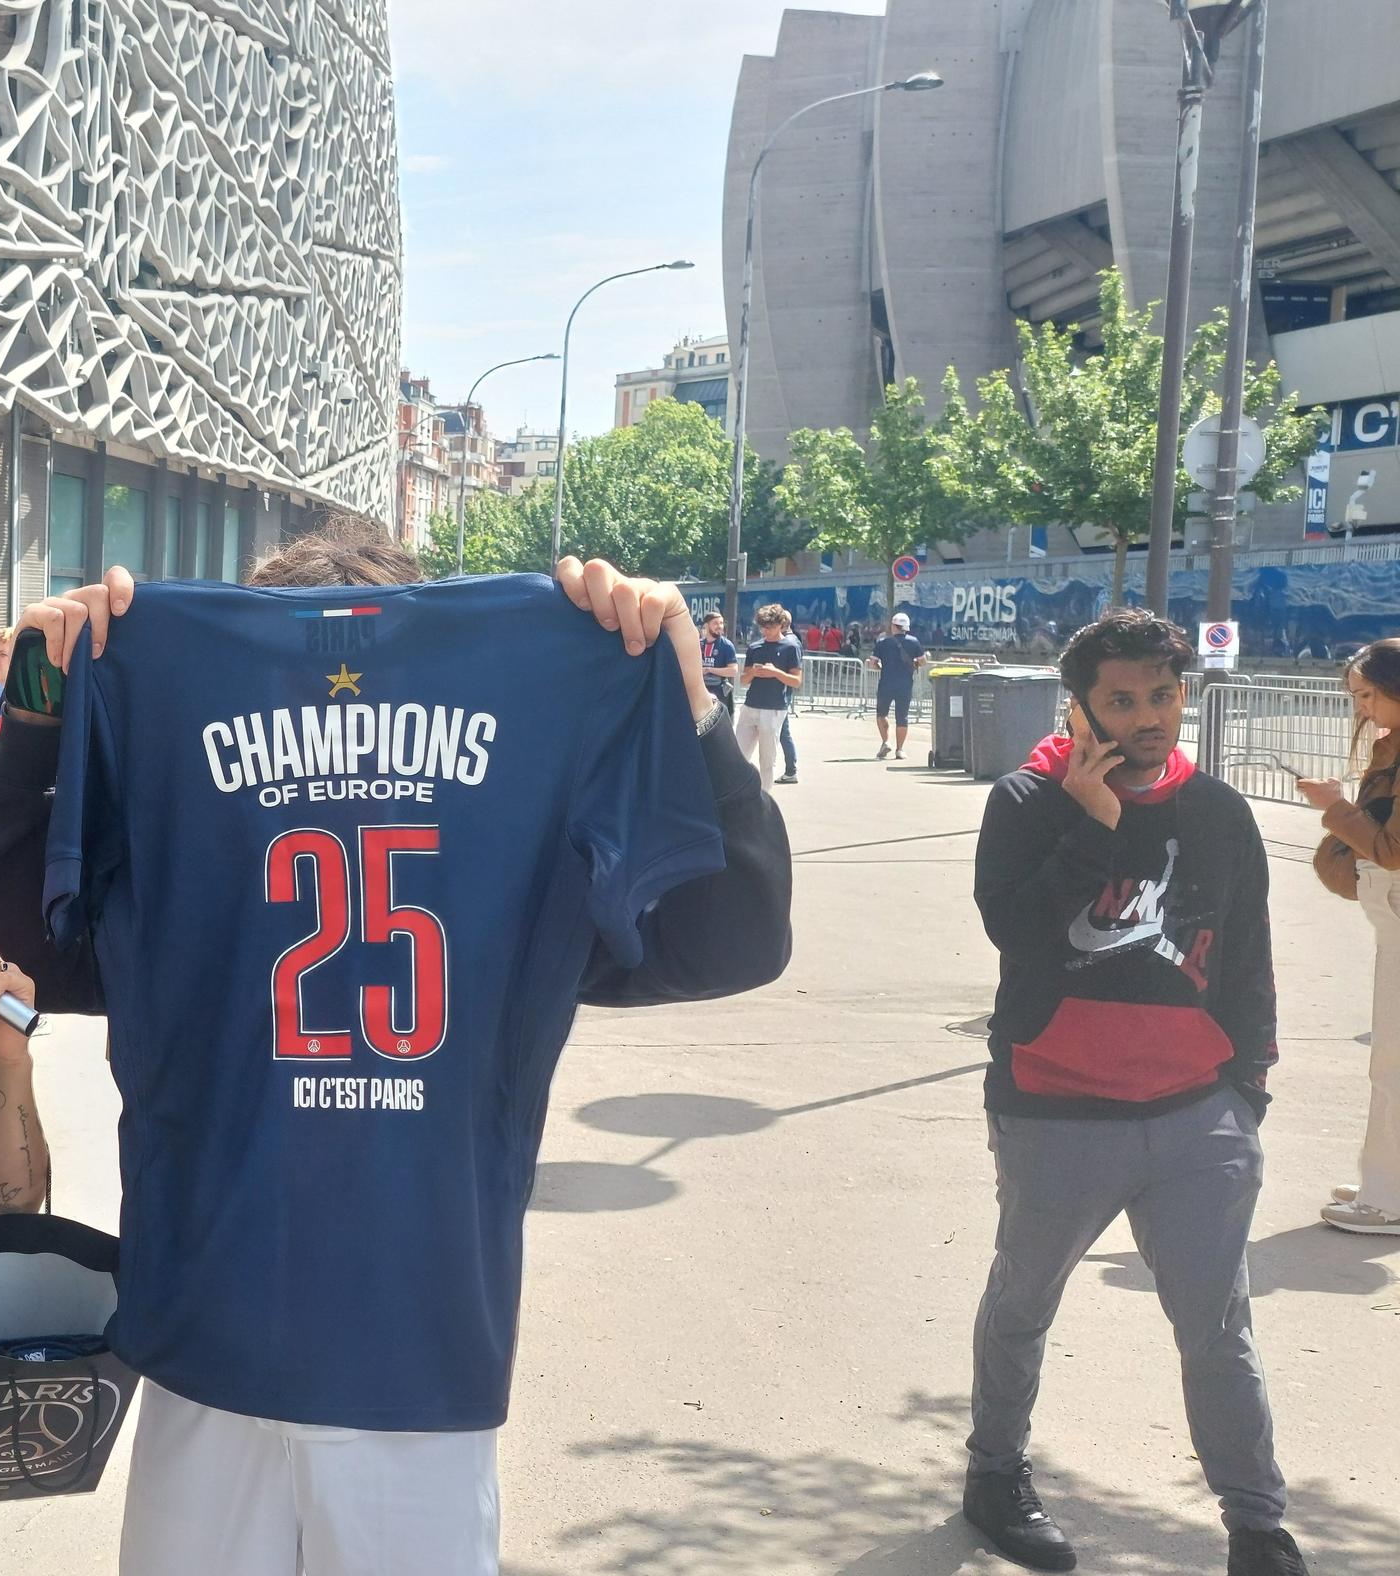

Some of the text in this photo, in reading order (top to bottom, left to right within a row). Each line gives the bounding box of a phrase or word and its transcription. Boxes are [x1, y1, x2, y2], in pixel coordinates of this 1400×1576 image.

[1308, 488, 1327, 509] ICI
[951, 584, 1018, 623] PARIS
[951, 626, 1018, 643] SAINT-GERMAIN
[202, 702, 497, 794] CHAMPIONS
[258, 779, 435, 808] OF EUROPE
[265, 824, 448, 1062] 25
[293, 1077, 425, 1111] ICI C'EST PARIS
